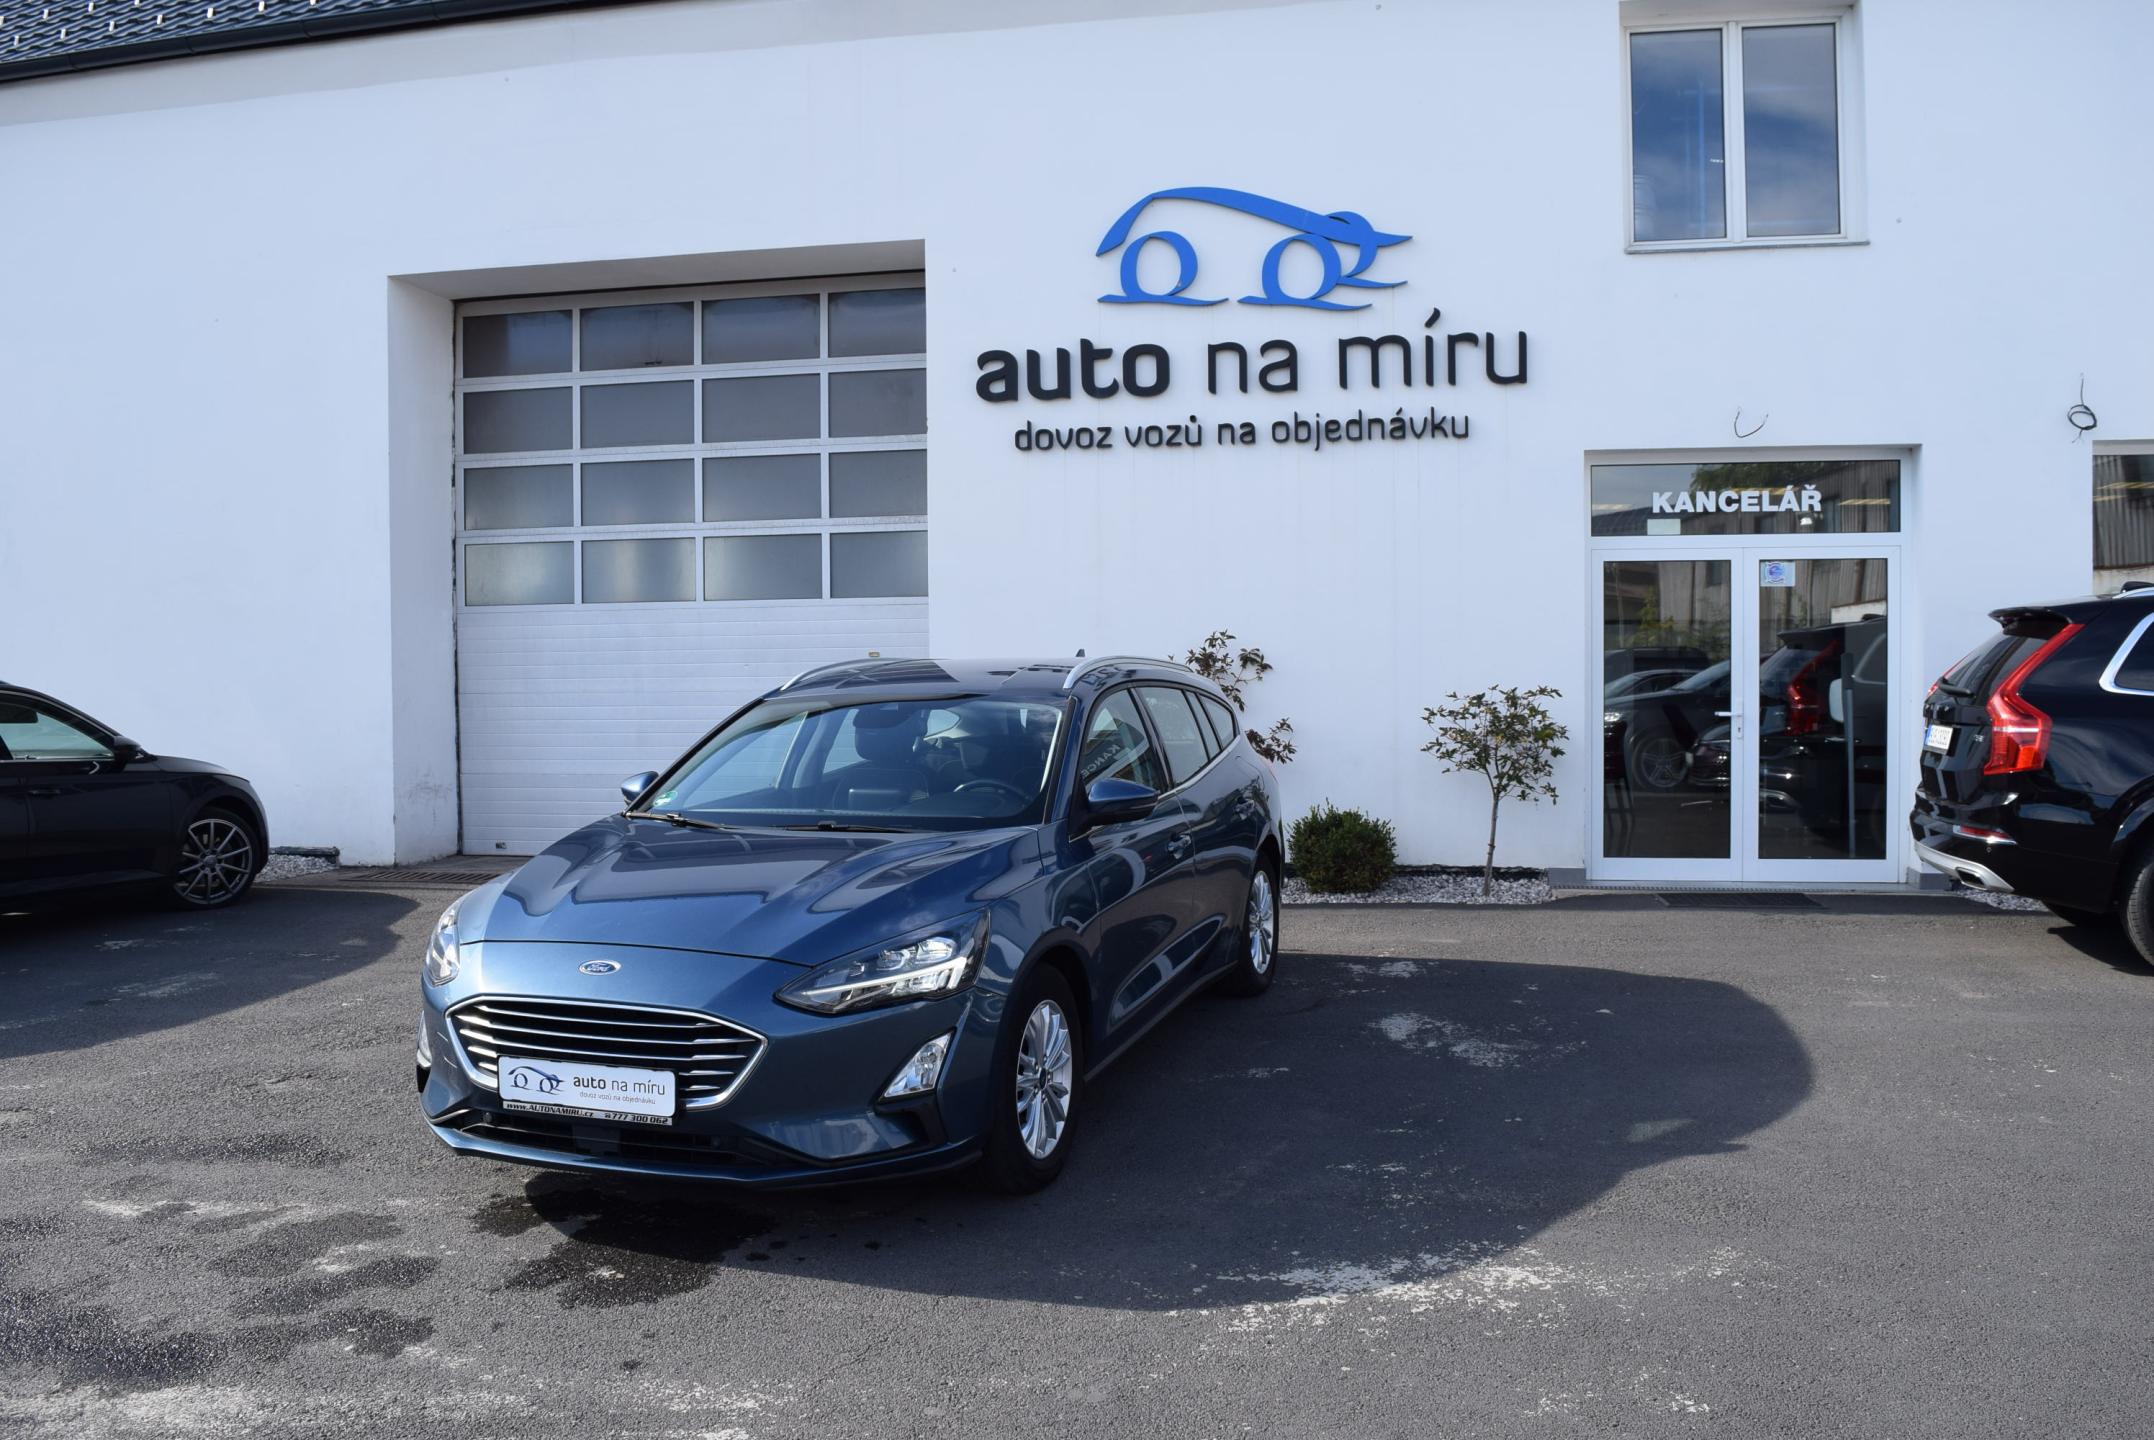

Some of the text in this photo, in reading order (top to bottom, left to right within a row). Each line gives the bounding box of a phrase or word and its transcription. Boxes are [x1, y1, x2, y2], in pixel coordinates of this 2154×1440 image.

[976, 307, 1528, 402] auto na míru
[1015, 406, 1470, 452] dovoz vozů na objednávku
[1652, 484, 1822, 514] KANCELÁŘ
[573, 1076, 666, 1095] auto na míru
